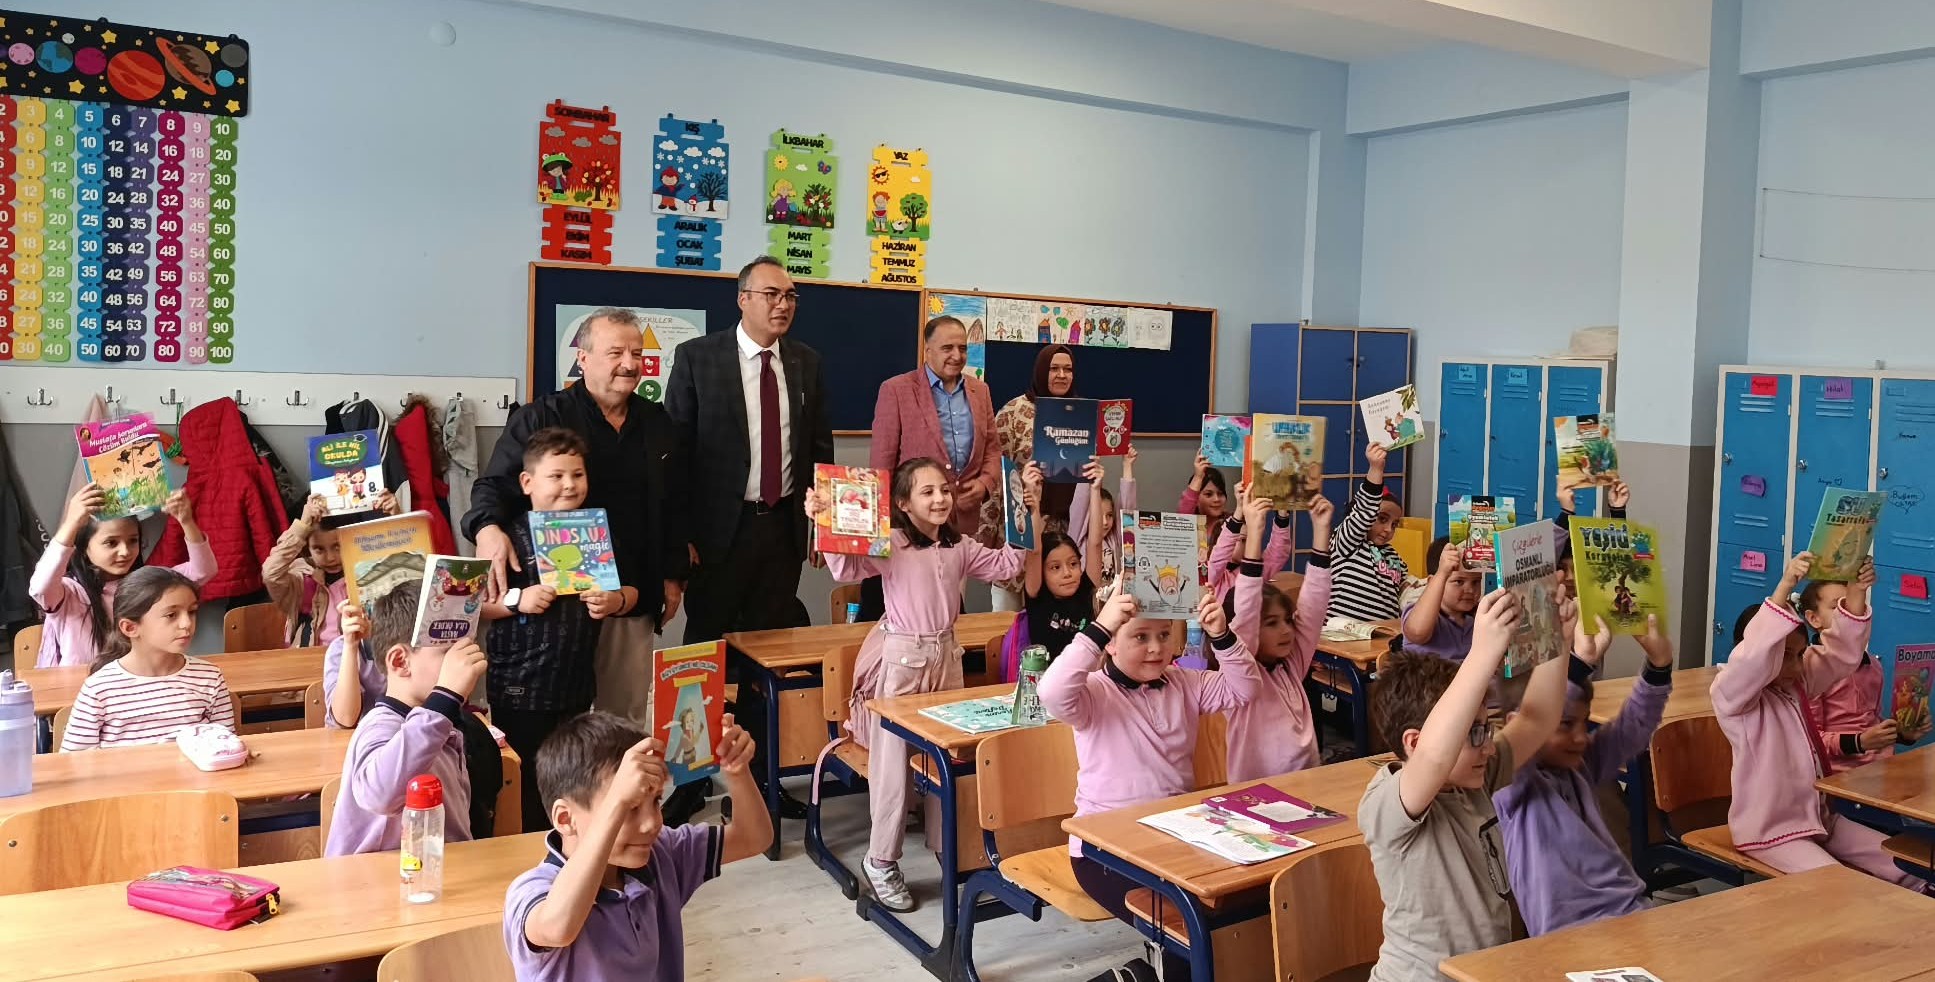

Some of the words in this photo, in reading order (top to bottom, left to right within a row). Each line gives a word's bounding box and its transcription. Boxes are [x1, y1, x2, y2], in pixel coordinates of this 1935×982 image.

[26, 106, 35, 116] 3
[54, 108, 64, 120] 4
[85, 111, 93, 121] 5
[112, 115, 120, 125] 6
[139, 117, 147, 127] 7
[167, 120, 175, 130] 8
[193, 123, 201, 133] 9
[216, 124, 230, 134] 10
[685, 122, 700, 135] KIŞ
[26, 132, 34, 143] 6
[54, 135, 64, 146] 8
[81, 137, 96, 148] 10
[109, 141, 124, 152] 12
[133, 142, 148, 153] 14
[162, 145, 177, 156] 16
[190, 148, 204, 159] 18
[215, 150, 231, 161] 20
[783, 133, 824, 148] İLKBAHAR
[893, 152, 908, 160] YAZ
[26, 159, 35, 169] 9
[51, 161, 66, 173] 12
[81, 164, 96, 174] 15
[108, 167, 123, 178] 18
[131, 168, 147, 179] 21
[162, 170, 179, 181] 24
[189, 173, 205, 184] 27
[214, 175, 230, 185] 30
[23, 185, 37, 196] 12
[49, 188, 66, 199] 16
[82, 189, 98, 200] 20
[107, 193, 125, 204] 24
[130, 193, 147, 204] 28
[161, 195, 178, 206] 32
[189, 198, 204, 209] 36
[214, 199, 230, 210] 40
[22, 212, 36, 223] 15
[49, 213, 66, 225] 20
[82, 215, 98, 226] 25
[107, 218, 123, 229] 30
[130, 218, 146, 229] 35
[160, 221, 177, 232] 40
[189, 223, 205, 234] 45
[214, 224, 230, 235] 50
[674, 221, 707, 232] ARALIK
[788, 231, 812, 241] MART
[23, 237, 36, 249] 18
[48, 240, 66, 251] 24
[81, 241, 97, 252] 30
[107, 243, 123, 254] 36
[128, 243, 144, 254] 42
[160, 246, 177, 257] 48
[189, 248, 206, 259] 54
[213, 249, 230, 260] 60
[676, 239, 703, 250] OCAK
[882, 242, 916, 252] HAZİRAN
[561, 250, 592, 260] KASIM
[787, 248, 812, 258] NİSAN
[675, 256, 704, 266] ŞUBAT
[883, 258, 915, 267] TEMMUZ
[21, 263, 36, 274] 21
[47, 266, 65, 277] 28
[81, 266, 97, 277] 35
[106, 269, 123, 280] 42
[127, 268, 143, 280] 49
[160, 271, 176, 282] 56
[189, 273, 205, 283] 63
[214, 274, 229, 284] 70
[787, 265, 812, 274] MAYIS
[881, 273, 917, 284] AĞUSTOS
[19, 290, 36, 301] 24
[47, 292, 65, 303] 32
[81, 291, 97, 302] 40
[106, 295, 122, 306] 48
[127, 295, 143, 305] 56
[160, 296, 176, 307] 64
[189, 298, 205, 308] 72
[214, 298, 229, 309] 80
[18, 316, 36, 327] 27
[47, 318, 64, 330] 36
[80, 318, 97, 329] 45
[106, 320, 122, 331] 54
[126, 320, 141, 331] 63
[159, 321, 176, 332] 72
[189, 322, 204, 332] 81
[213, 323, 229, 333] 90
[17, 343, 35, 354] 30
[45, 344, 63, 355] 40
[81, 344, 97, 355] 50
[105, 344, 120, 356] 60
[125, 345, 139, 356] 70
[158, 345, 174, 356] 80
[189, 346, 205, 357] 90
[210, 346, 231, 358] 100
[1043, 426, 1089, 438] Ramazan
[89, 433, 117, 448] Mustafa
[535, 527, 607, 545] DINOSAUR
[580, 542, 609, 556] magic
[1515, 553, 1543, 572] OSMANLI
